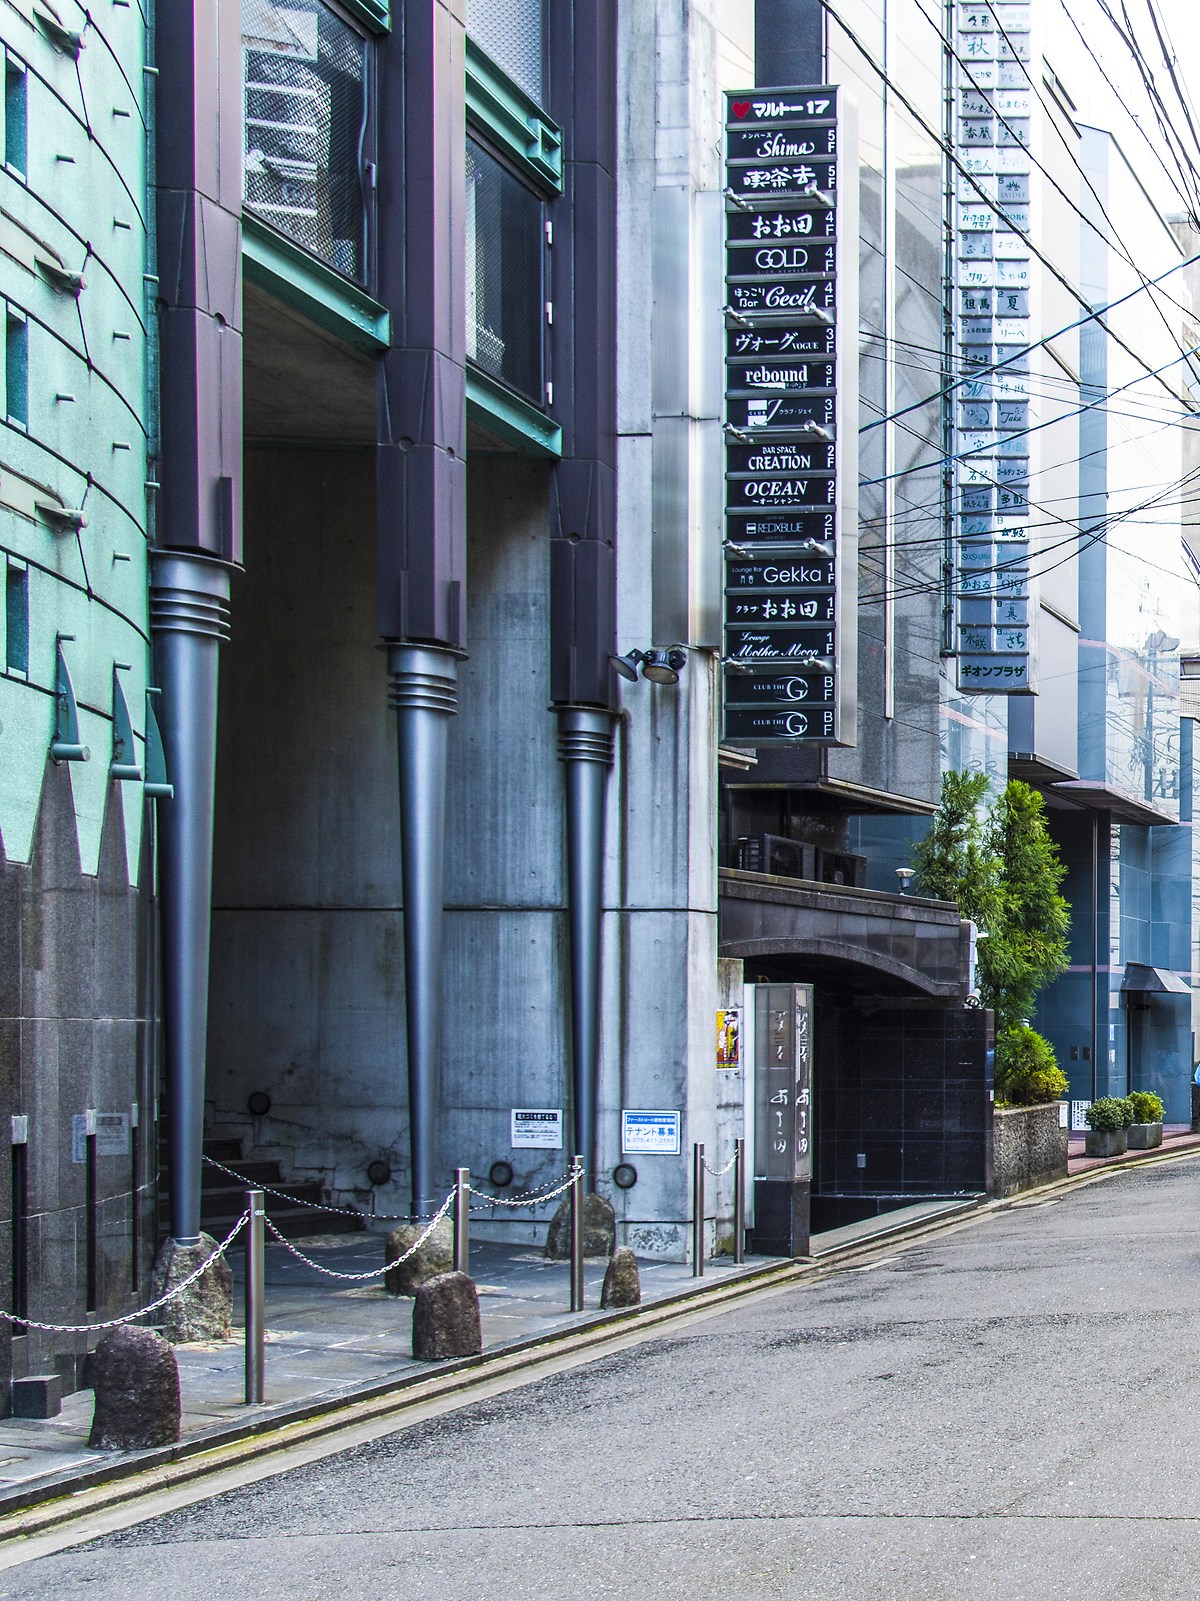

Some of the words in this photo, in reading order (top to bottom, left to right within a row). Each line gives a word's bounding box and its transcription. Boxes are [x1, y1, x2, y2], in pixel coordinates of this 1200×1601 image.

[967, 37, 990, 55] 秋
[963, 101, 992, 114] らんまん
[756, 133, 815, 157] Shima
[756, 248, 808, 269] GOLD
[734, 287, 765, 298] ほっこり
[740, 299, 758, 307] Bar
[964, 298, 990, 310] 但馬
[1007, 295, 1019, 311] 夏
[1001, 329, 1025, 337] リーベ
[735, 332, 799, 352] ヴォーグ
[792, 342, 819, 350] VOGUE
[744, 365, 808, 382] rebound
[777, 446, 797, 454] SPACE
[748, 455, 811, 471] CREATION
[744, 481, 808, 496] OCEAN
[763, 566, 821, 583] Gekka
[961, 580, 991, 589] かおる
[736, 605, 759, 614] クラブ
[1006, 632, 1025, 648] さち
[732, 644, 780, 657] Mother
[626, 1127, 675, 1136] テナント募集
